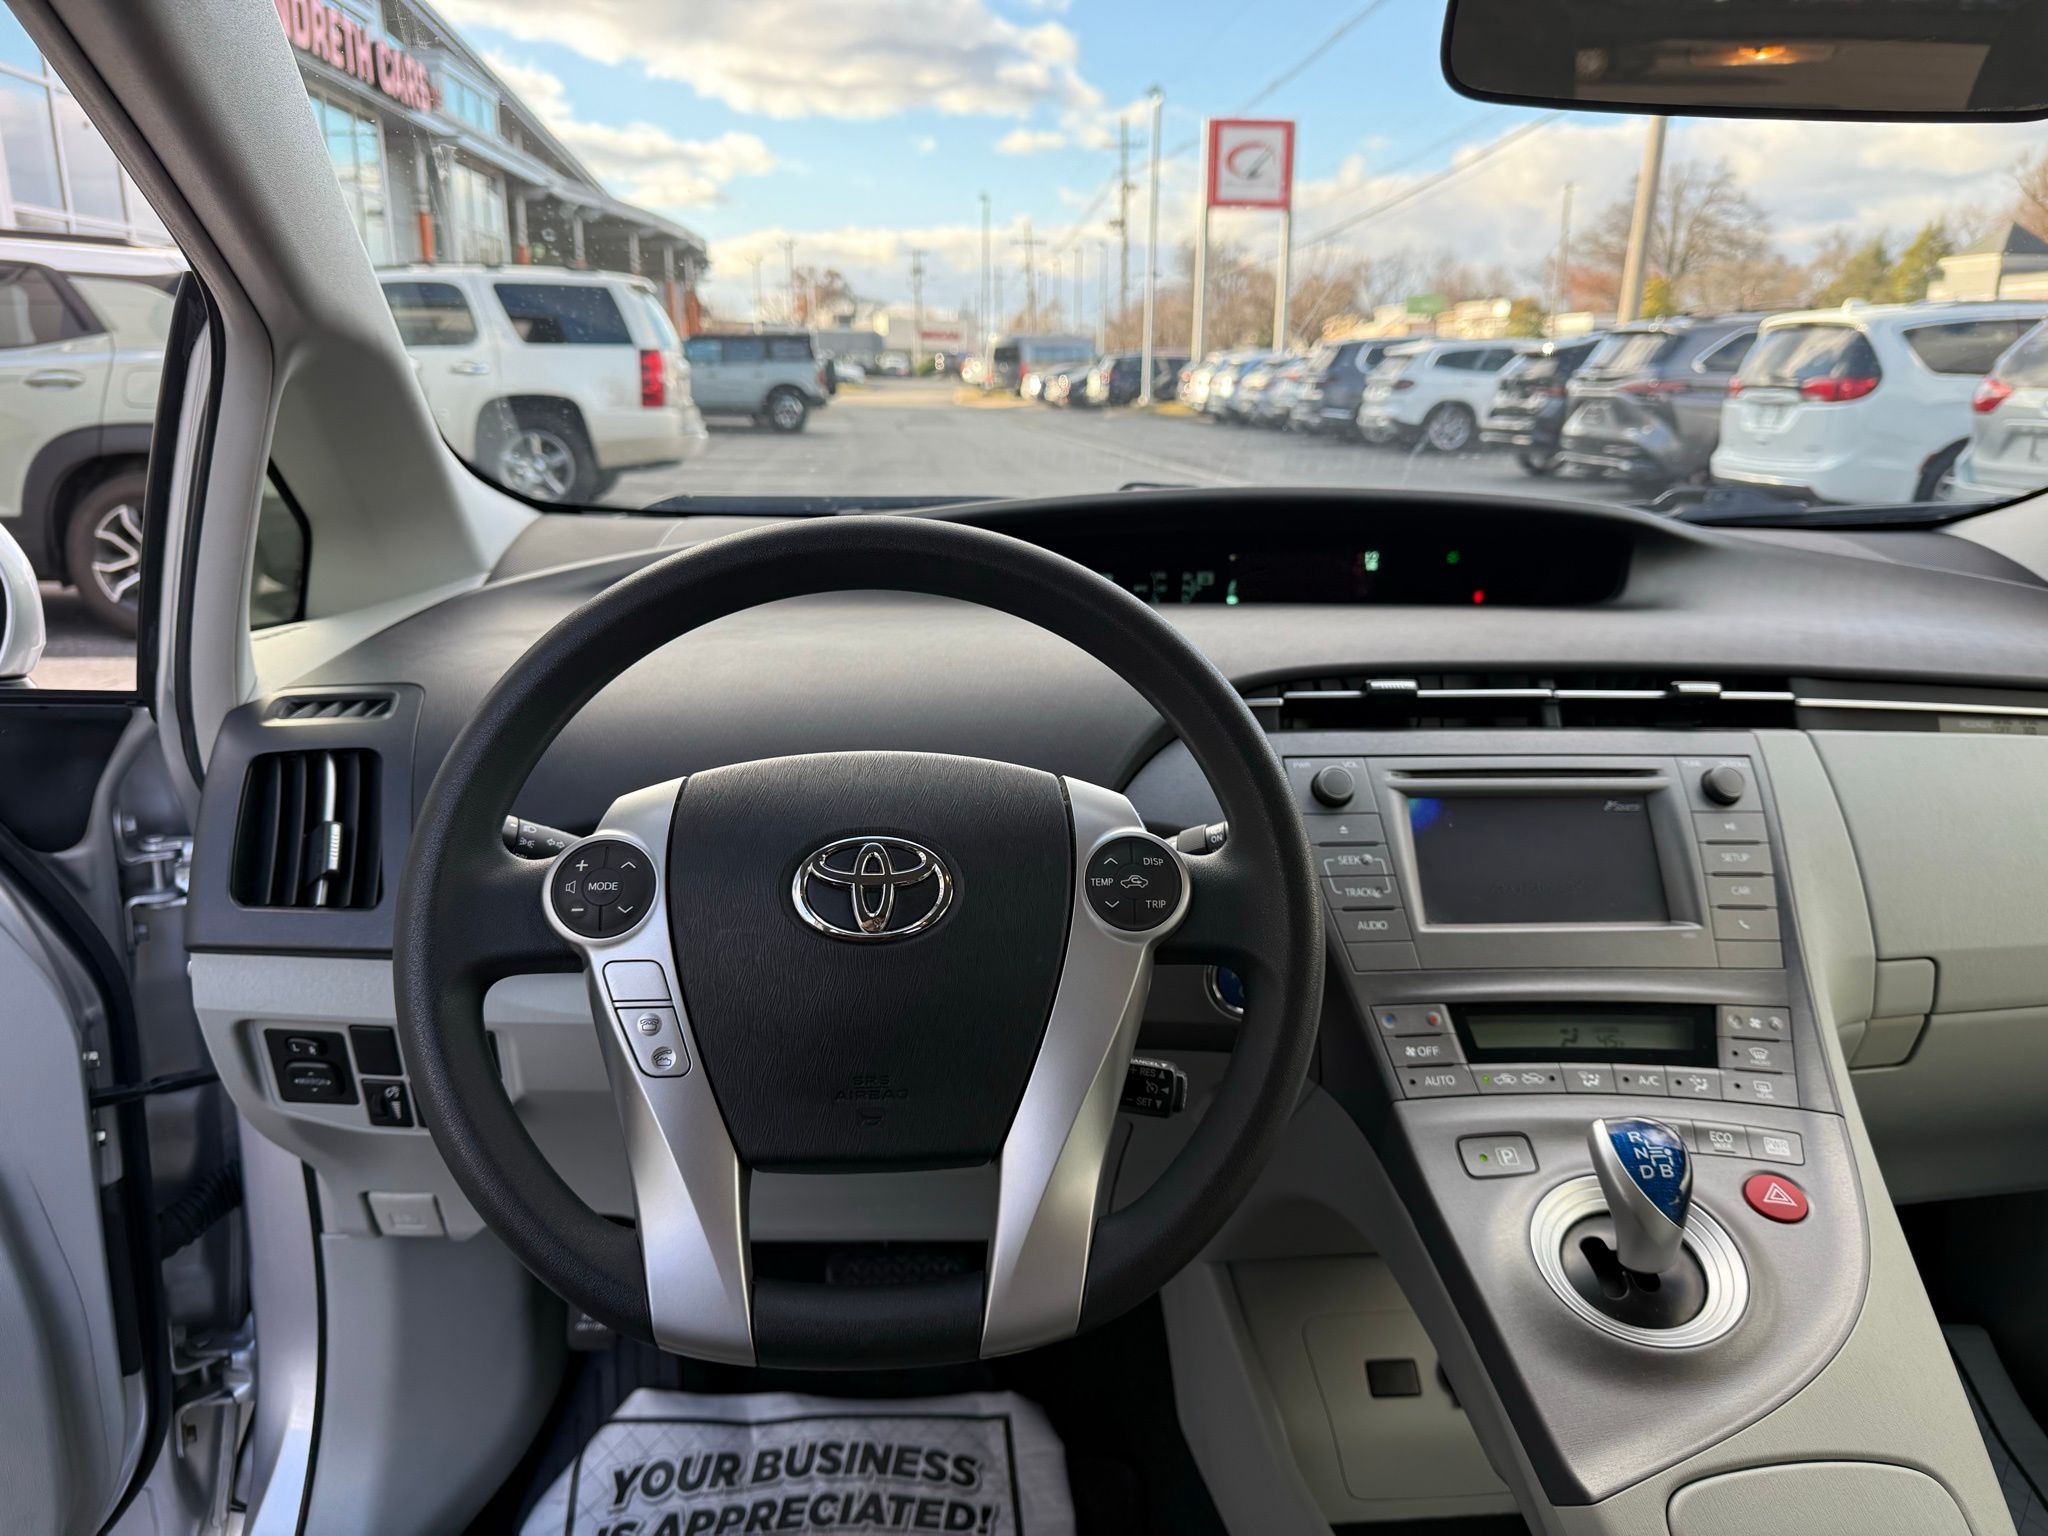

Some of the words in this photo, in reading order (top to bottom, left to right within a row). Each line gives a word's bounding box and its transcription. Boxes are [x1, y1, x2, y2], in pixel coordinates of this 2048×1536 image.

[1211, 833, 1223, 843] ON
[1143, 857, 1164, 866] DISP
[1338, 855, 1360, 865] SEEK
[1721, 852, 1751, 862] SETUP
[588, 881, 619, 891] MODE
[1091, 877, 1114, 887] TEMP
[1344, 887, 1373, 897] TRACK
[1730, 885, 1751, 895] CAR
[1145, 899, 1167, 909] TRIP
[1357, 920, 1389, 931] AUDIO
[1417, 1045, 1441, 1058] OFF
[1140, 1067, 1157, 1078] RES
[1424, 1075, 1456, 1087] AUTO
[1638, 1074, 1660, 1087] A/C
[1136, 1096, 1154, 1107] SET
[1627, 1131, 1643, 1144] R
[1709, 1130, 1734, 1143] ECO
[1634, 1146, 1650, 1160] N
[1639, 1164, 1655, 1179] D
[1659, 1164, 1675, 1178] B
[612, 1453, 741, 1506] YOUR
[751, 1442, 980, 1487] BUSINESS
[652, 1491, 993, 1536] APPRECIATED!
